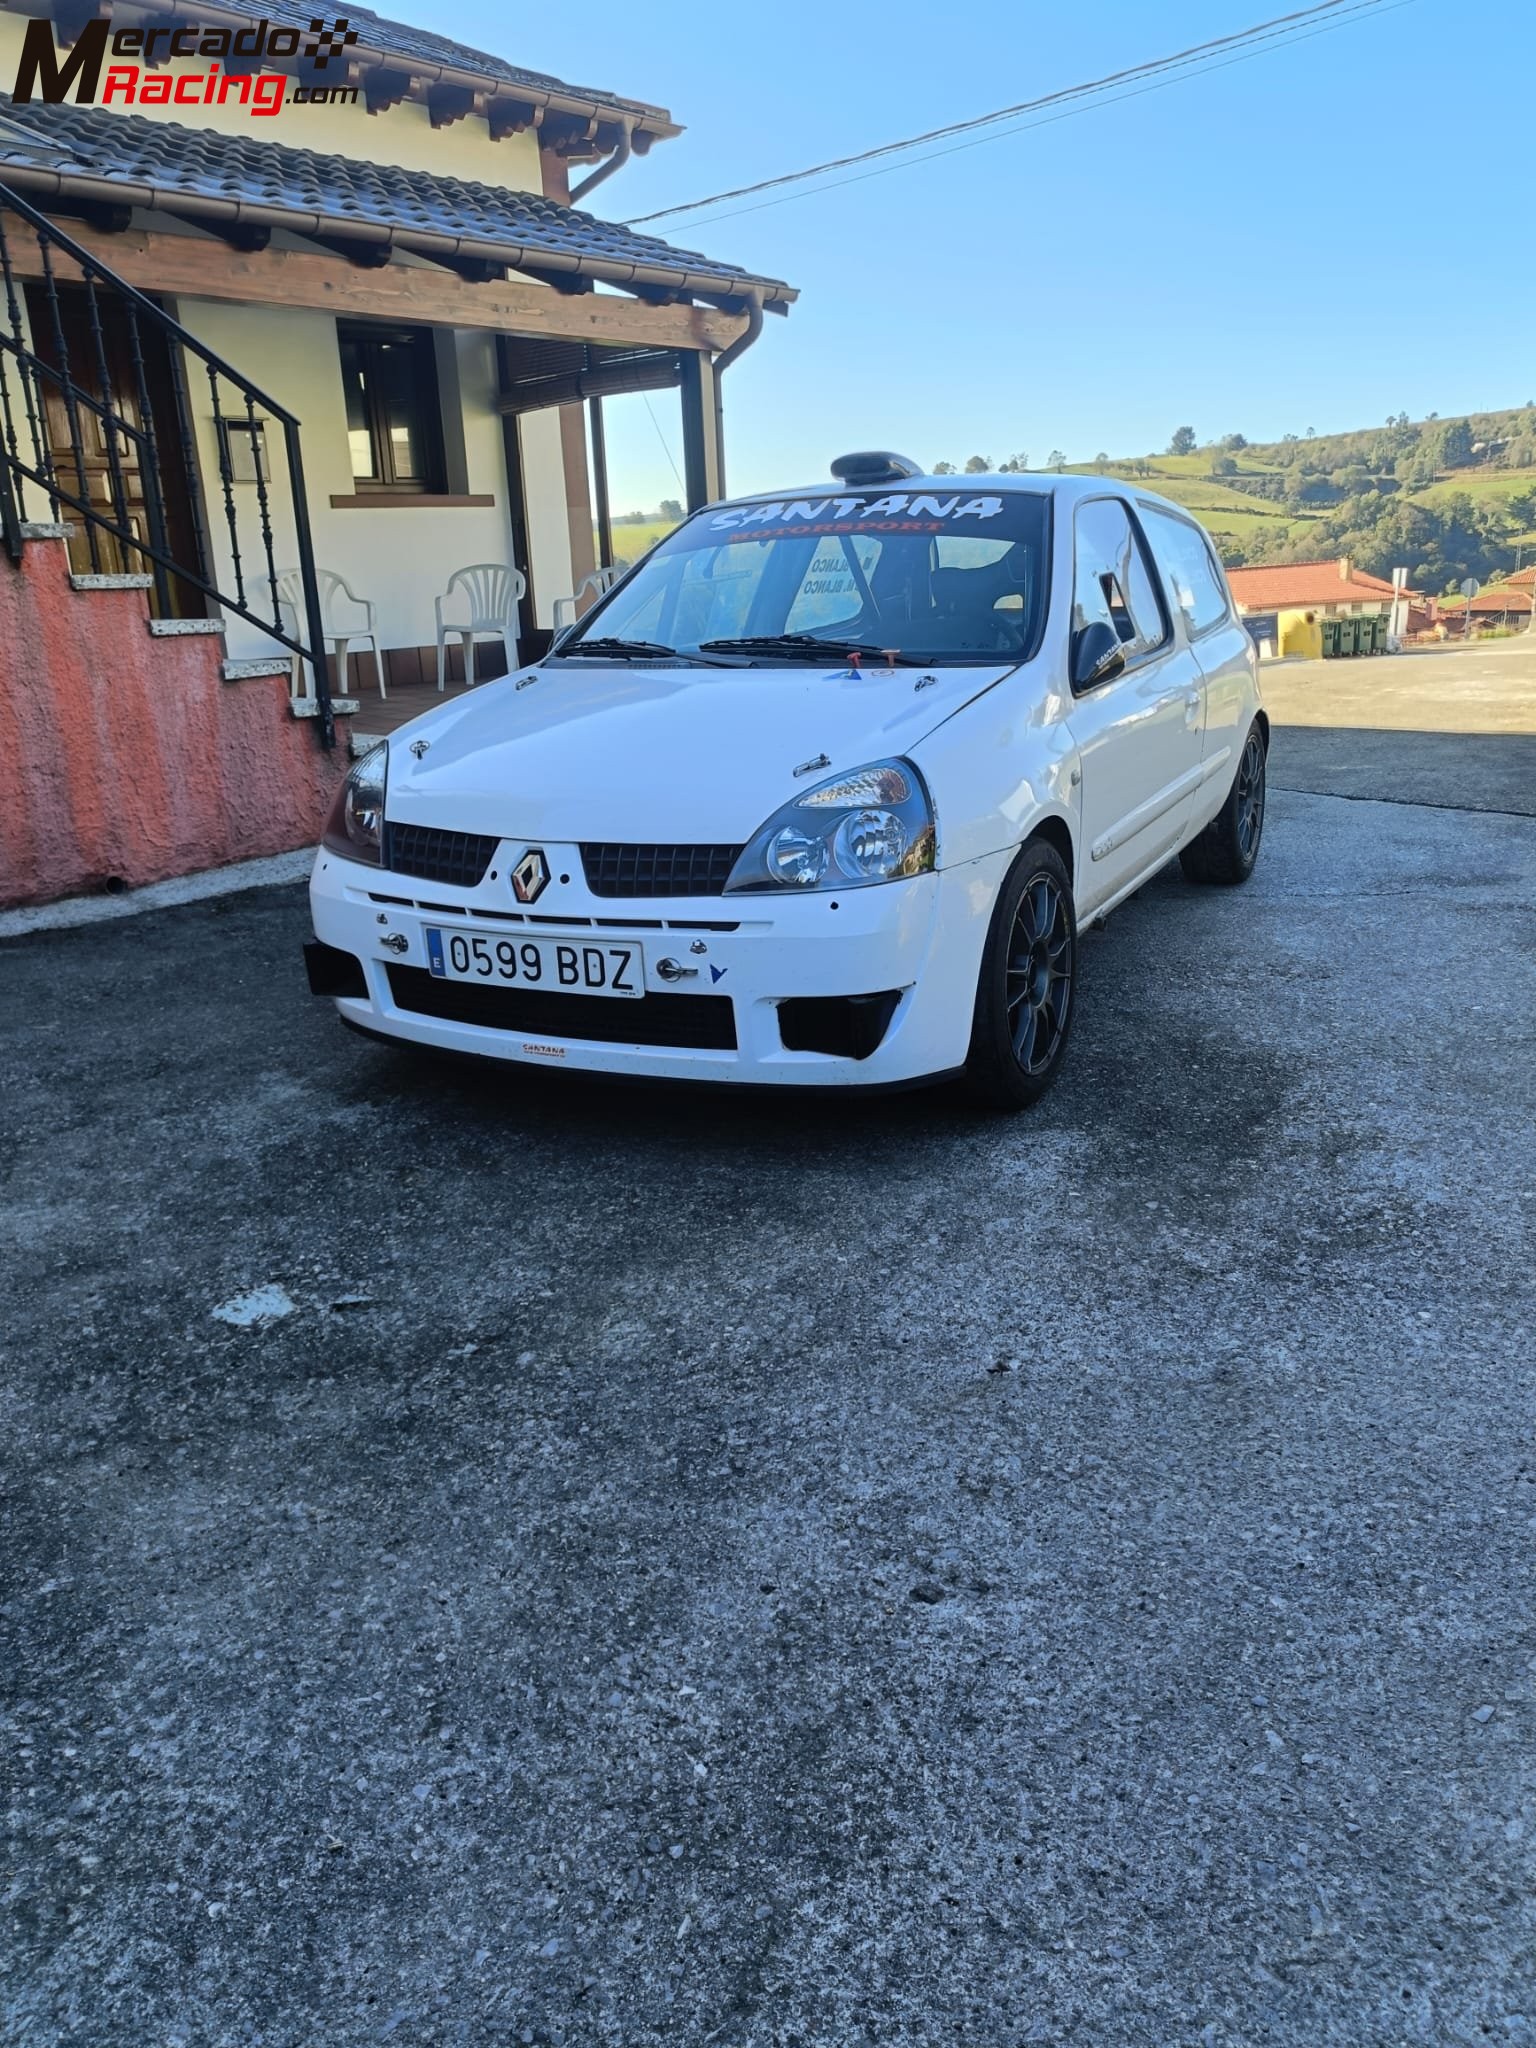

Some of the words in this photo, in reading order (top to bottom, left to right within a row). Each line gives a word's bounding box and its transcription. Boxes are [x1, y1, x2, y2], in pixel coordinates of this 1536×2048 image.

[709, 494, 1003, 531] SANTANA
[728, 521, 944, 543] MOTORSPORT
[433, 957, 441, 968] E
[450, 936, 542, 982] 0599
[556, 946, 634, 990] BDZ
